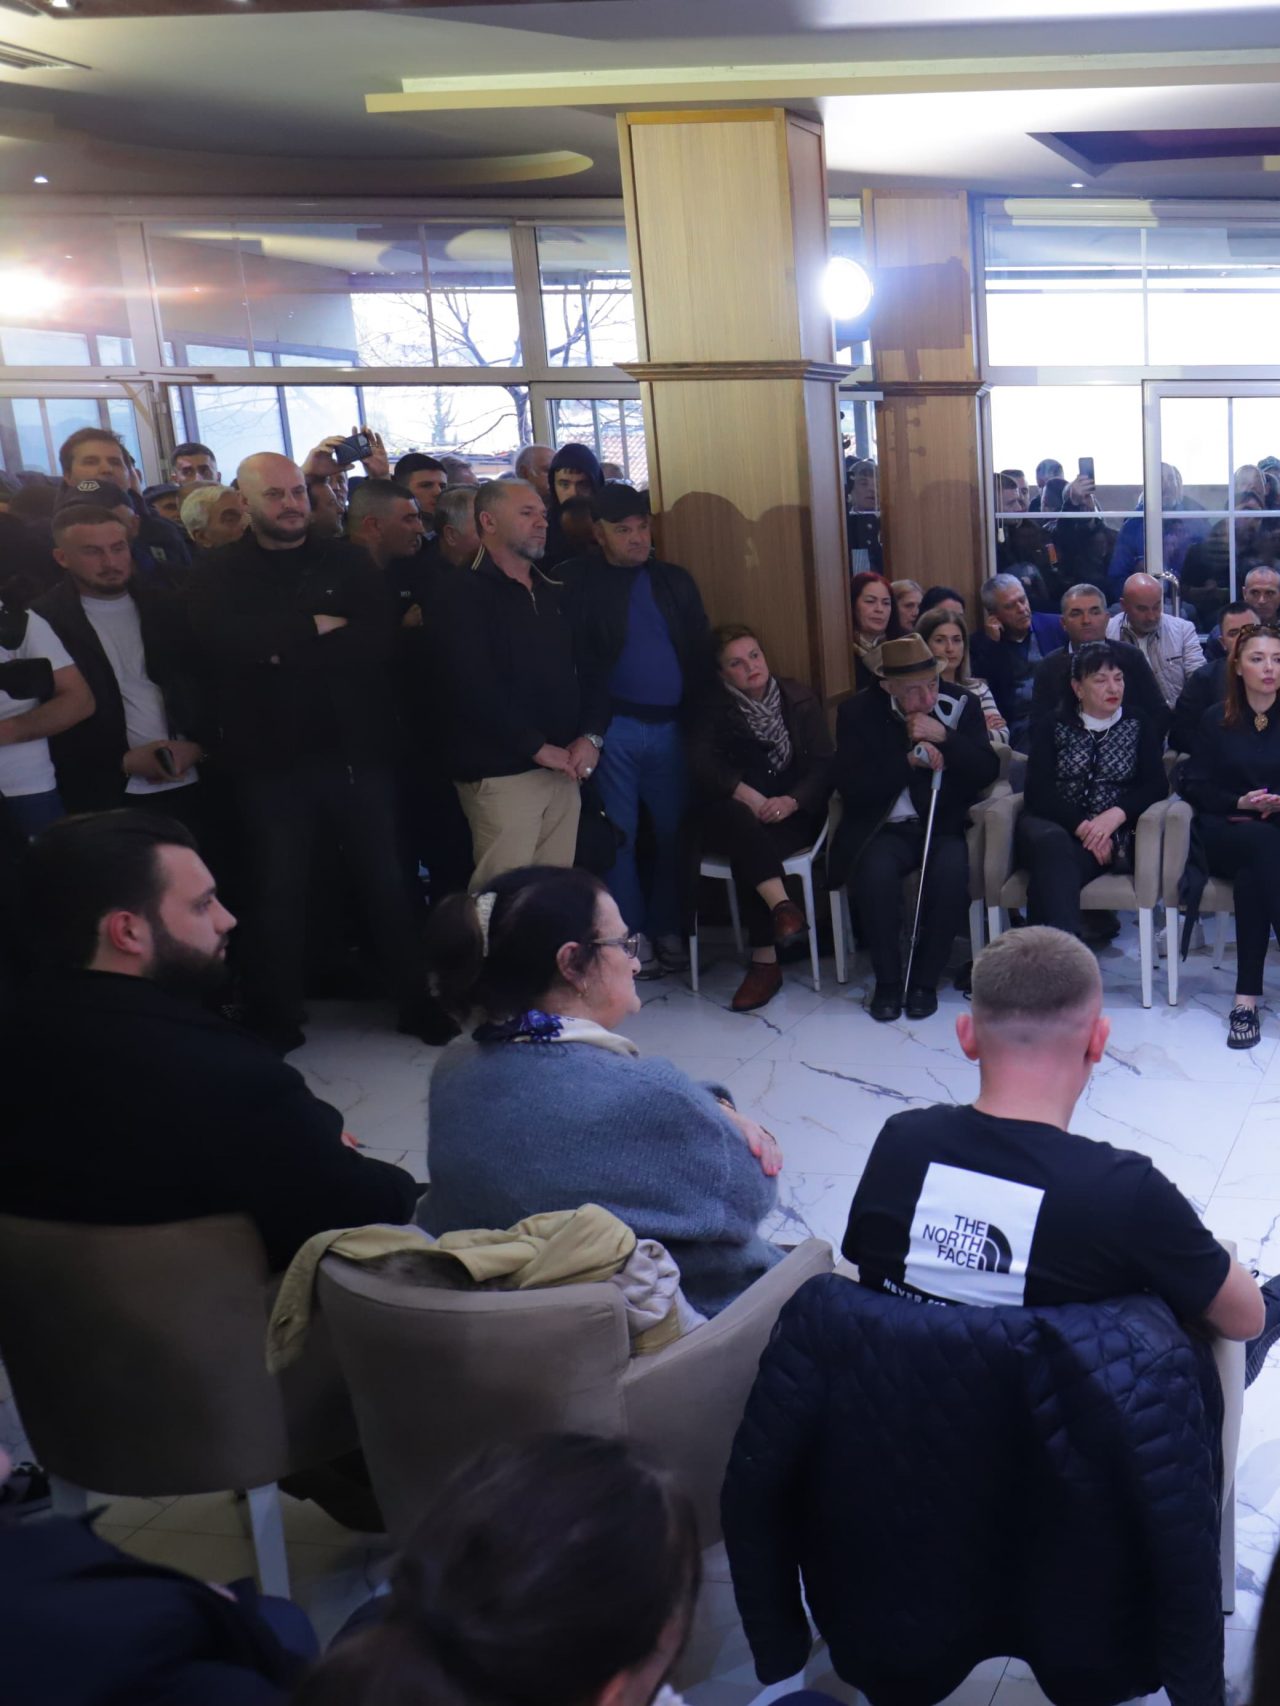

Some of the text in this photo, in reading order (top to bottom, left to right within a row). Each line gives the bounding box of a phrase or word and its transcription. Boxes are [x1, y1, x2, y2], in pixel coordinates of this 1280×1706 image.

[922, 1223, 983, 1253] NORTH
[954, 1214, 987, 1238] THE
[937, 1244, 978, 1270] FACE
